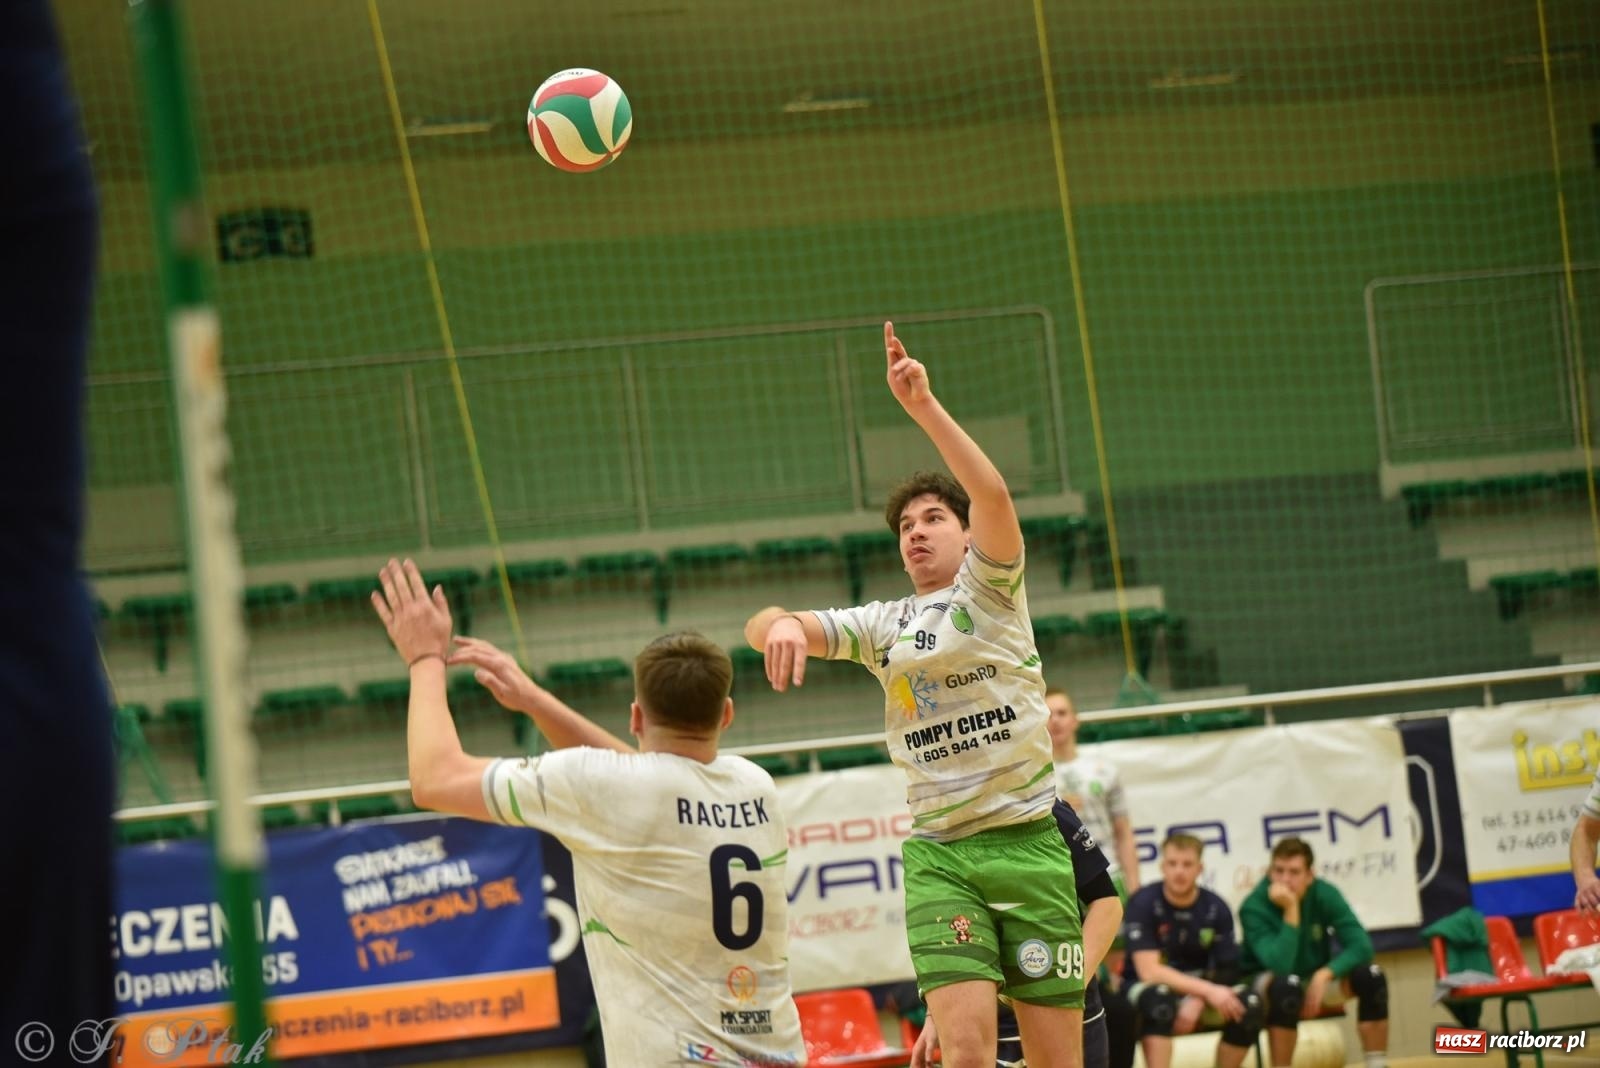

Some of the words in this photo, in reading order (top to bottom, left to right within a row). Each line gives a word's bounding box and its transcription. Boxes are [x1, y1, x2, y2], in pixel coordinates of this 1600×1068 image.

[914, 629, 937, 651] 99
[945, 664, 998, 690] GUARD
[904, 720, 954, 751] POMPY
[956, 704, 1018, 736] CIEPŁA
[923, 745, 950, 764] 605
[952, 736, 980, 755] 944
[982, 727, 1012, 746] 146
[676, 796, 770, 829] RACZEK
[709, 843, 764, 951] 6
[261, 951, 299, 985] 55
[1056, 942, 1084, 980] 99
[720, 1010, 739, 1024] MK
[740, 1009, 771, 1024] SPORT
